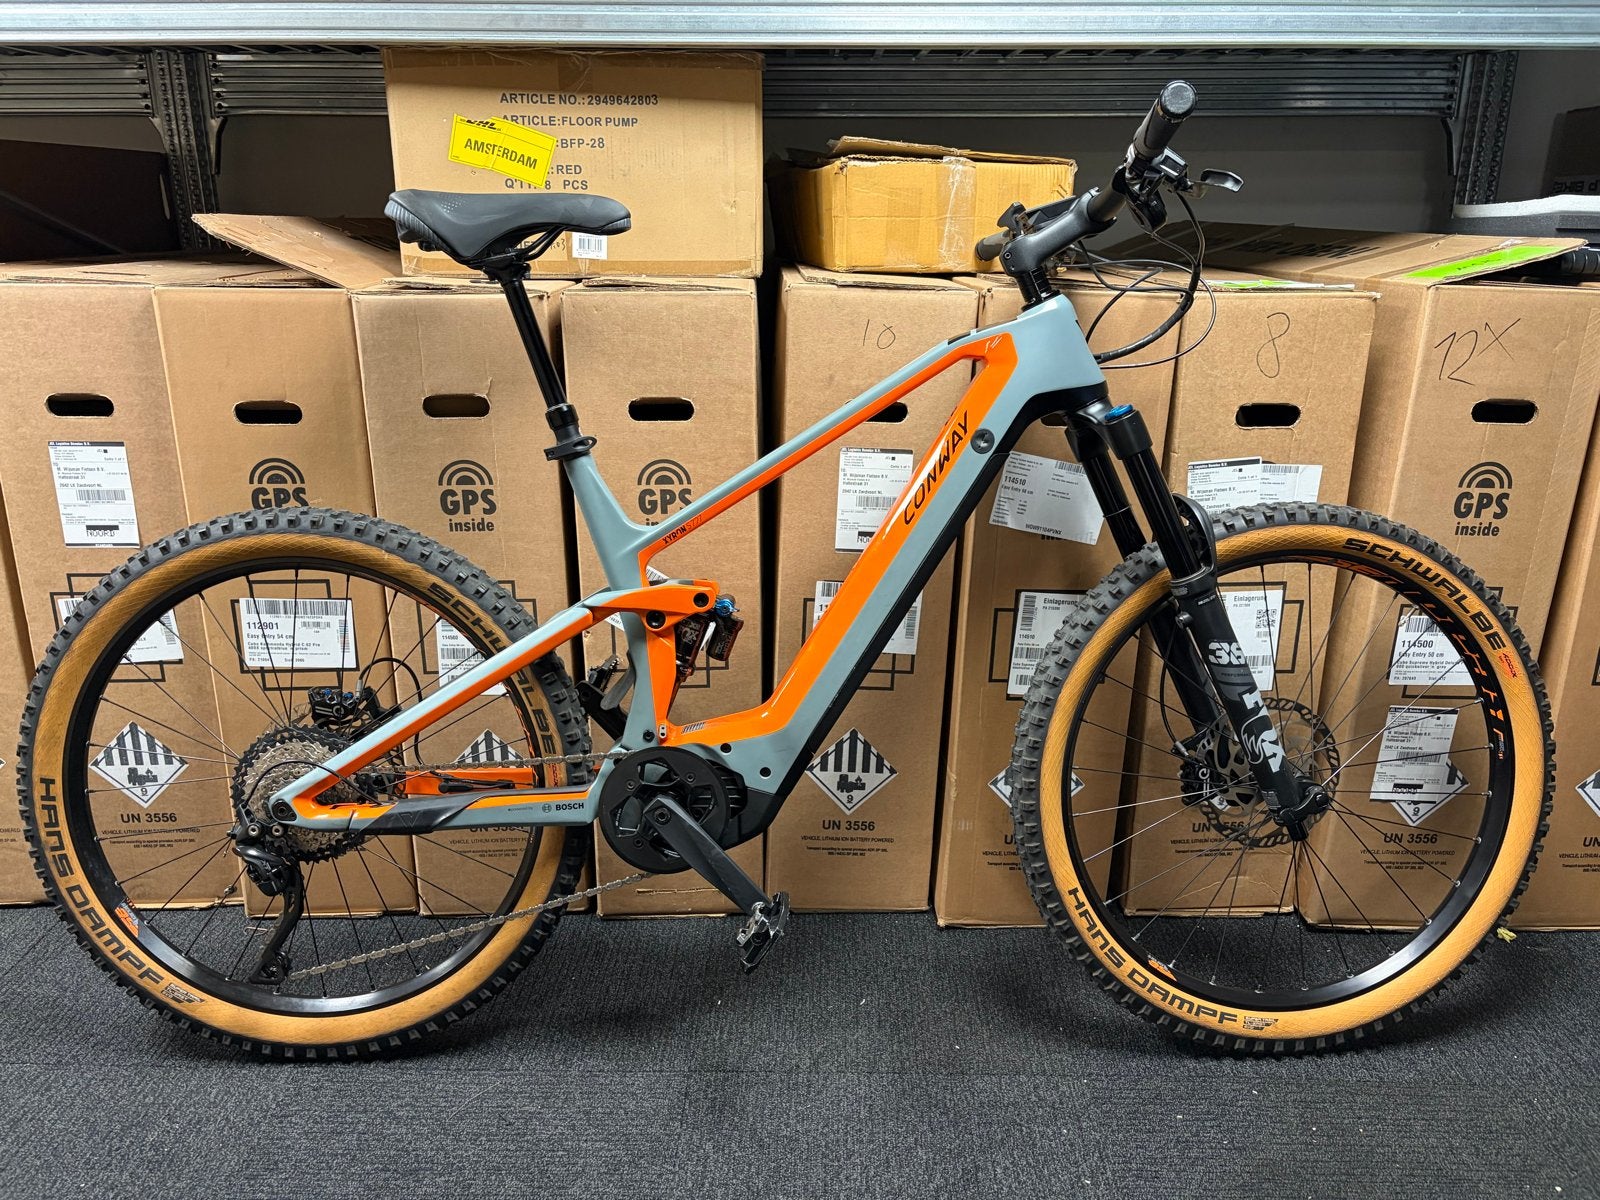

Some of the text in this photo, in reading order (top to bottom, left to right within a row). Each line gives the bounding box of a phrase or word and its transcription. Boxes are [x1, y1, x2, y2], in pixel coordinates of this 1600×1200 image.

[500, 93, 555, 105] ARTICLE
[606, 117, 638, 127] PUMP
[464, 138, 538, 170] AMSTERDAM
[563, 180, 588, 190] PCS
[1256, 312, 1291, 379] 8
[904, 410, 968, 525] CONWAY
[1004, 475, 1027, 486] 114510
[251, 487, 310, 510] GPS
[440, 488, 497, 516] GPS
[638, 488, 693, 515] GPS
[1453, 491, 1510, 520] GPS
[448, 517, 495, 533] inside
[1454, 521, 1500, 537] inside
[662, 525, 687, 545] XYRON
[1342, 537, 1507, 651] SCHWALBE
[246, 621, 280, 630] 112901
[1401, 640, 1434, 649] 114500
[1208, 642, 1246, 665] 36
[140, 787, 148, 796] 9
[846, 794, 854, 803] 9
[555, 802, 585, 811] BOSCH
[1413, 806, 1420, 815] 9
[120, 812, 178, 824] UN 3556
[822, 819, 876, 831] UN 3556
[1192, 822, 1211, 833] UN
[1004, 834, 1016, 845] U
[1383, 833, 1438, 844] UN 3556
[39, 776, 75, 878] HANS
[65, 883, 165, 985] DAMPF
[1067, 885, 1238, 1024] HANS DAMPF
